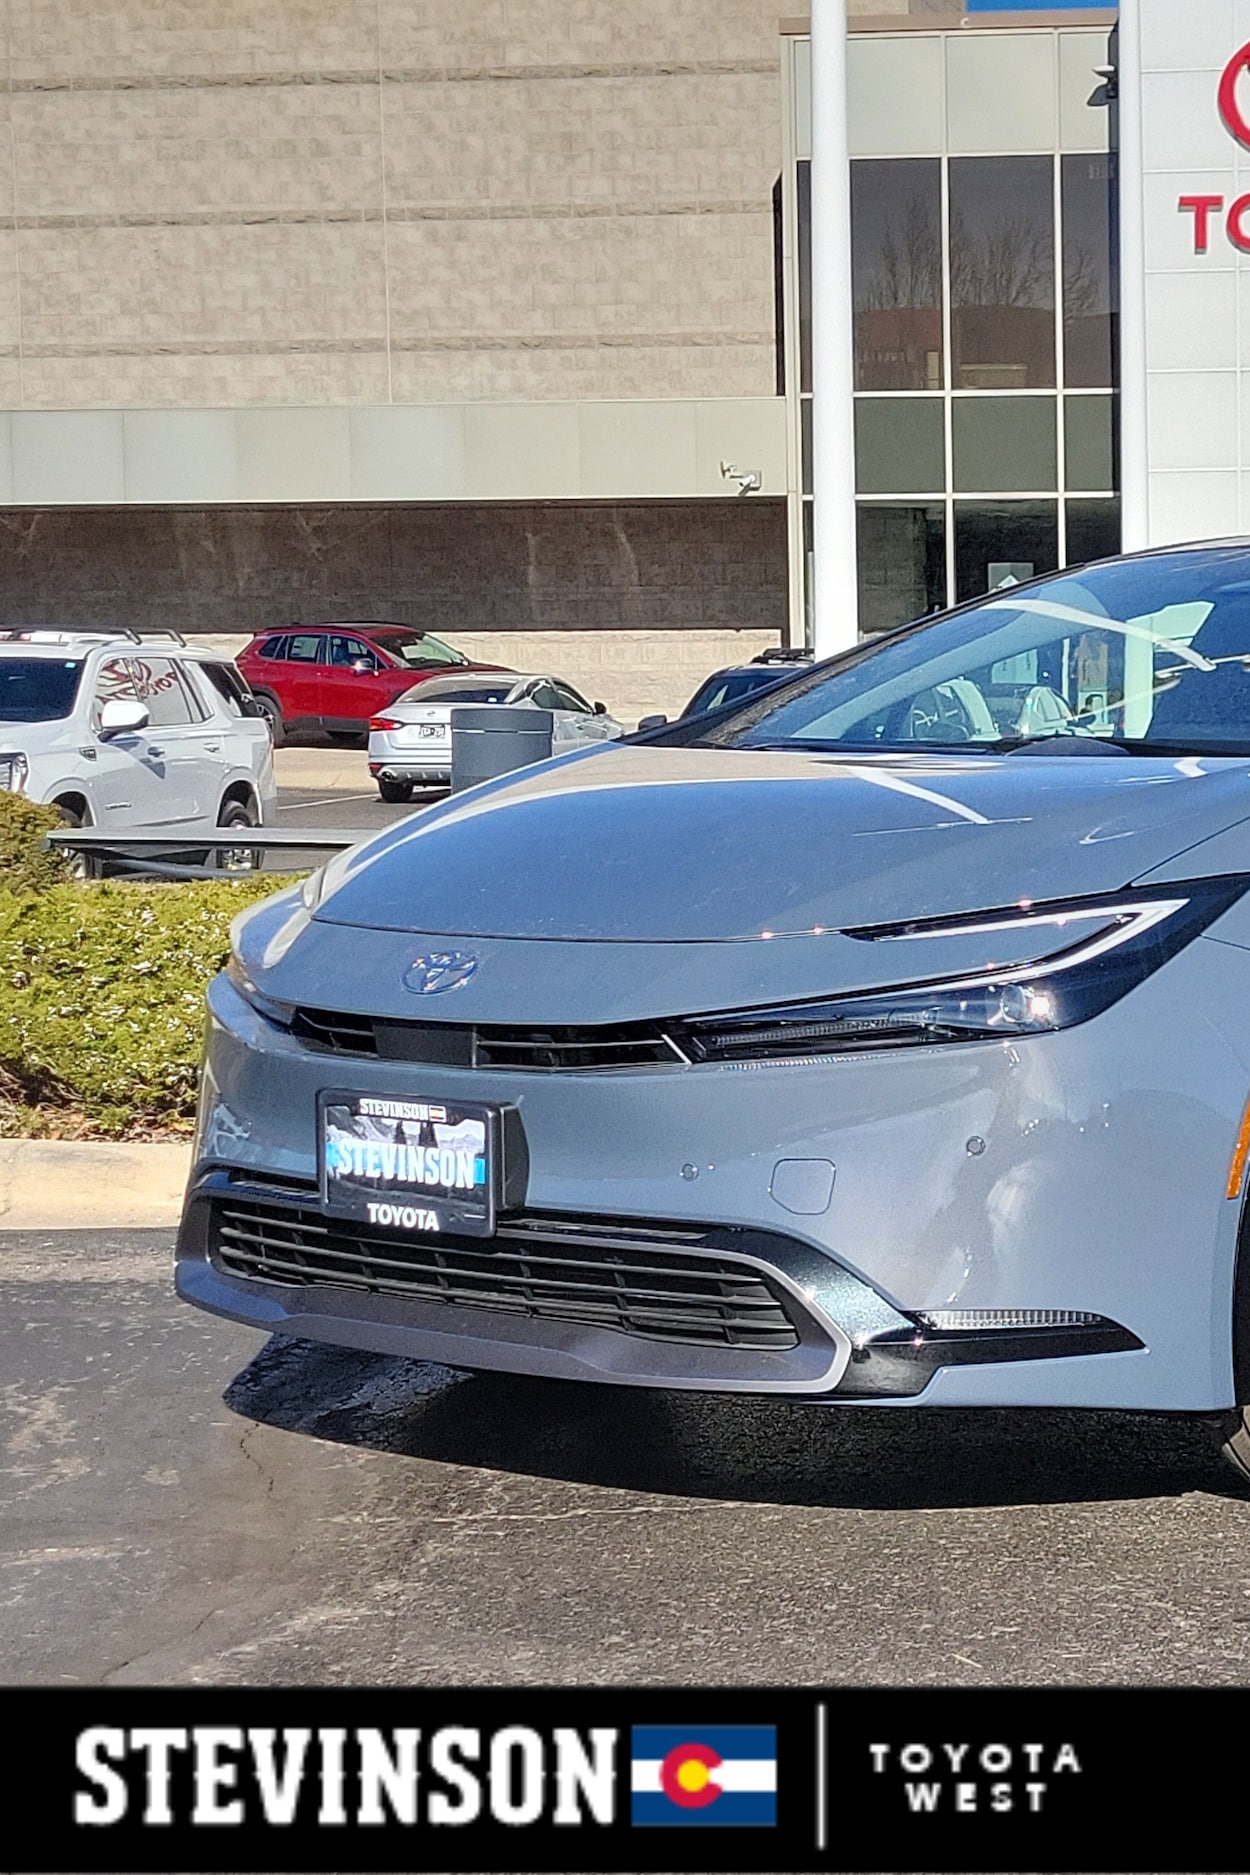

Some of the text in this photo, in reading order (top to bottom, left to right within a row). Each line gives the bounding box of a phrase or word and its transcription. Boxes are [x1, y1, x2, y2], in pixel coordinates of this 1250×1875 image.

[359, 1099, 430, 1121] STEVINSON
[337, 1138, 476, 1189] STEVINSON
[366, 1202, 440, 1232] TOYOTA
